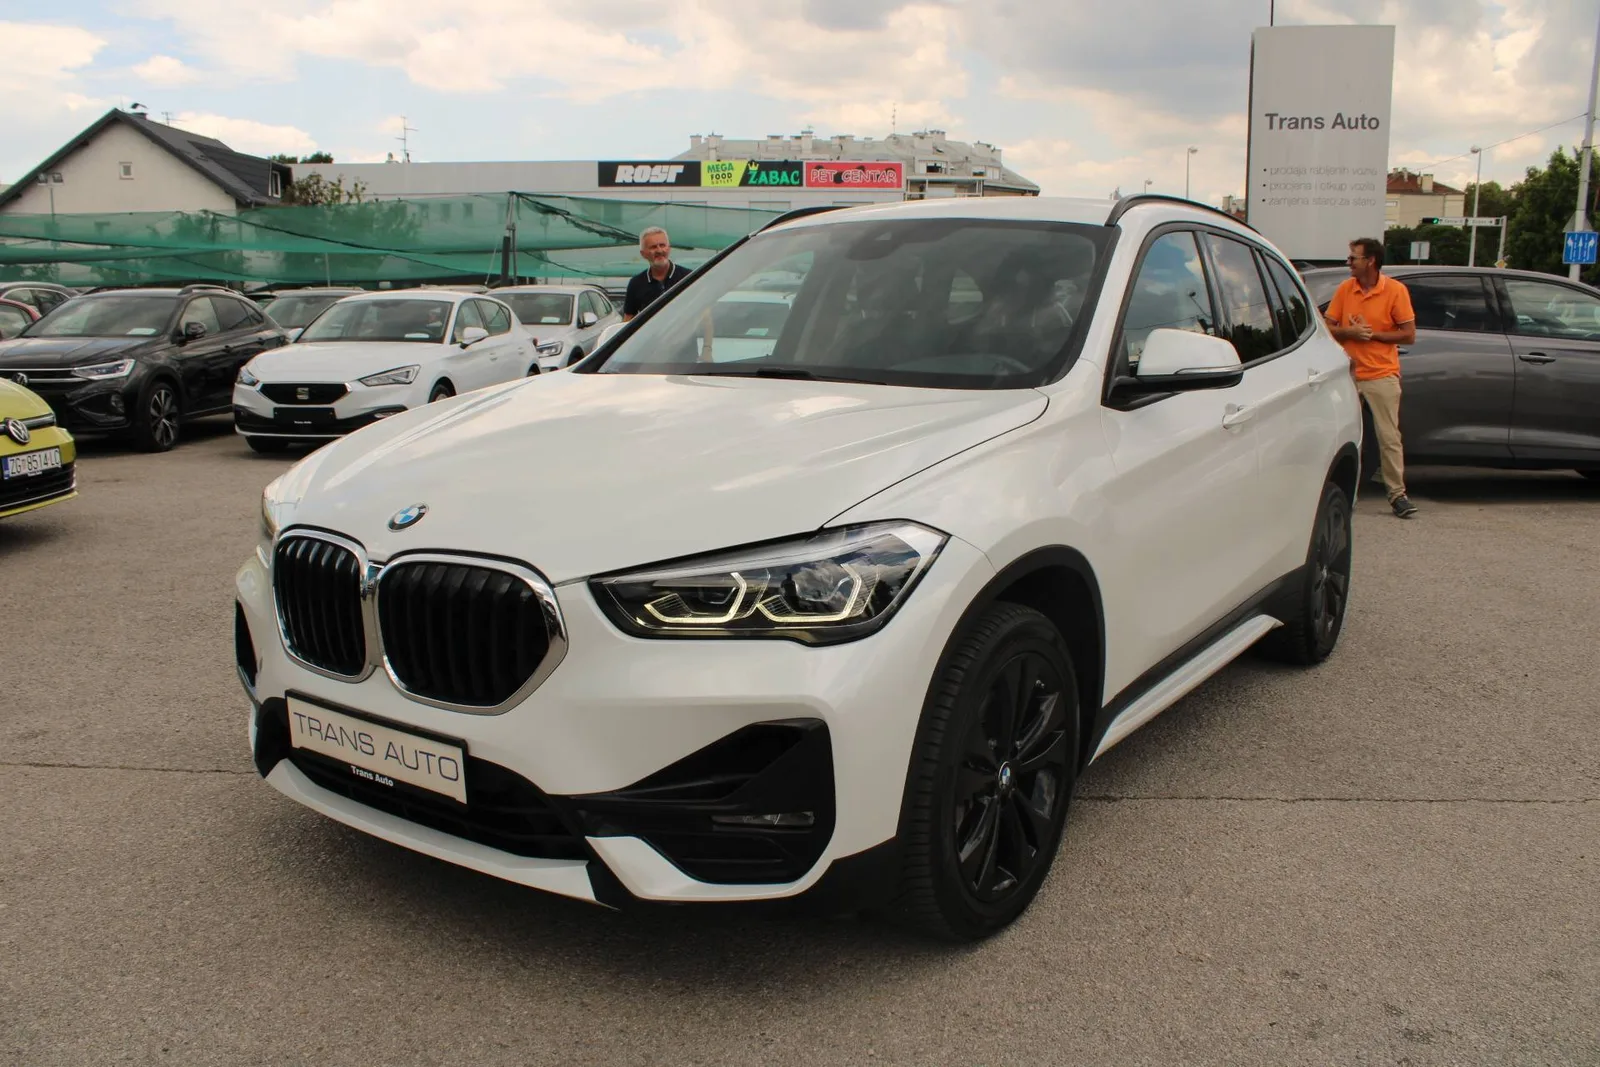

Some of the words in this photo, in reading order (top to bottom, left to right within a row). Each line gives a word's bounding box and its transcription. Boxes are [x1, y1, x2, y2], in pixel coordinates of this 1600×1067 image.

[1264, 113, 1325, 130] Trans
[1331, 112, 1380, 130] Auto
[707, 162, 734, 174] MEGA
[811, 168, 835, 182] PET
[841, 169, 897, 184] CENTAR
[710, 172, 733, 182] FOOD
[293, 712, 375, 756] TRANS
[384, 741, 459, 781] AUTO
[351, 765, 375, 781] Trans
[375, 774, 394, 787] Auto
